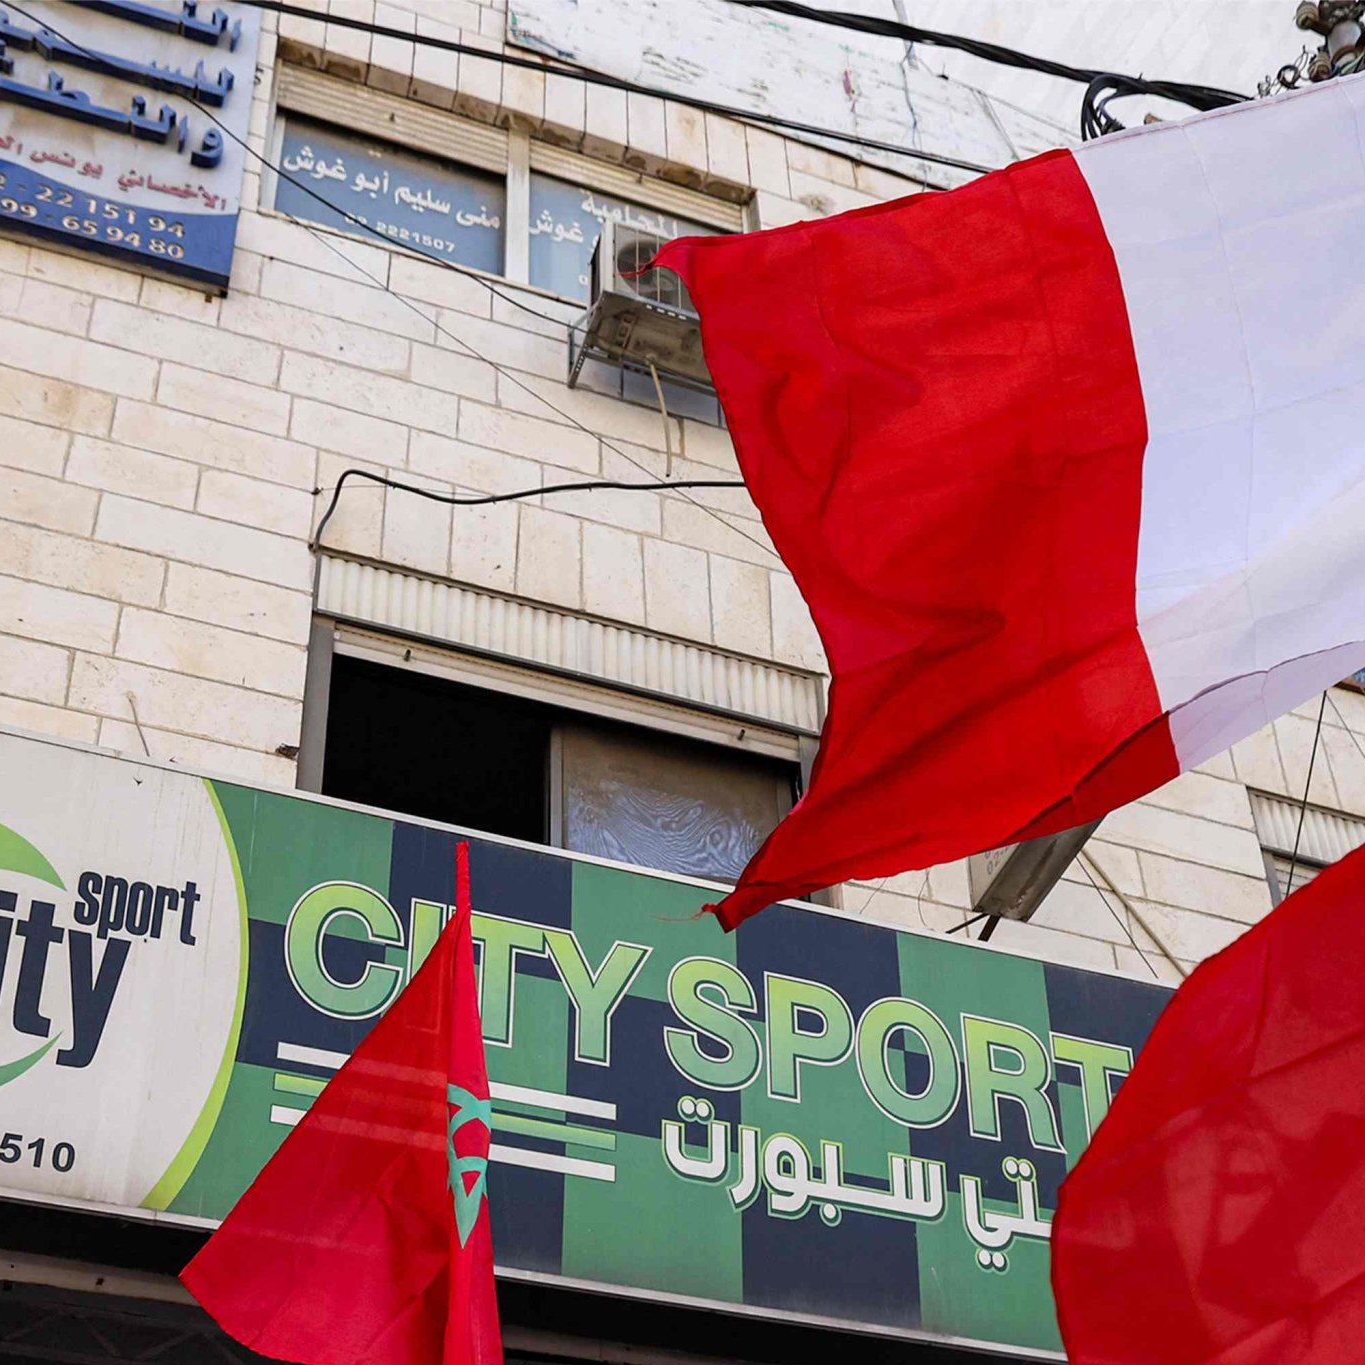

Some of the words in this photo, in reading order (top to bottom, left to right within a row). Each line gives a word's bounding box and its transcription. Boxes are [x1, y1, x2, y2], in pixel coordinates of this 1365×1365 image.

[282, 144, 348, 182] غوش
[34, 184, 75, 209] 22
[146, 215, 187, 240] 94
[61, 214, 99, 237] 65
[105, 225, 142, 249] 94
[148, 237, 187, 261] 80
[73, 869, 202, 947] sport
[661, 1096, 947, 1226] سبورت
